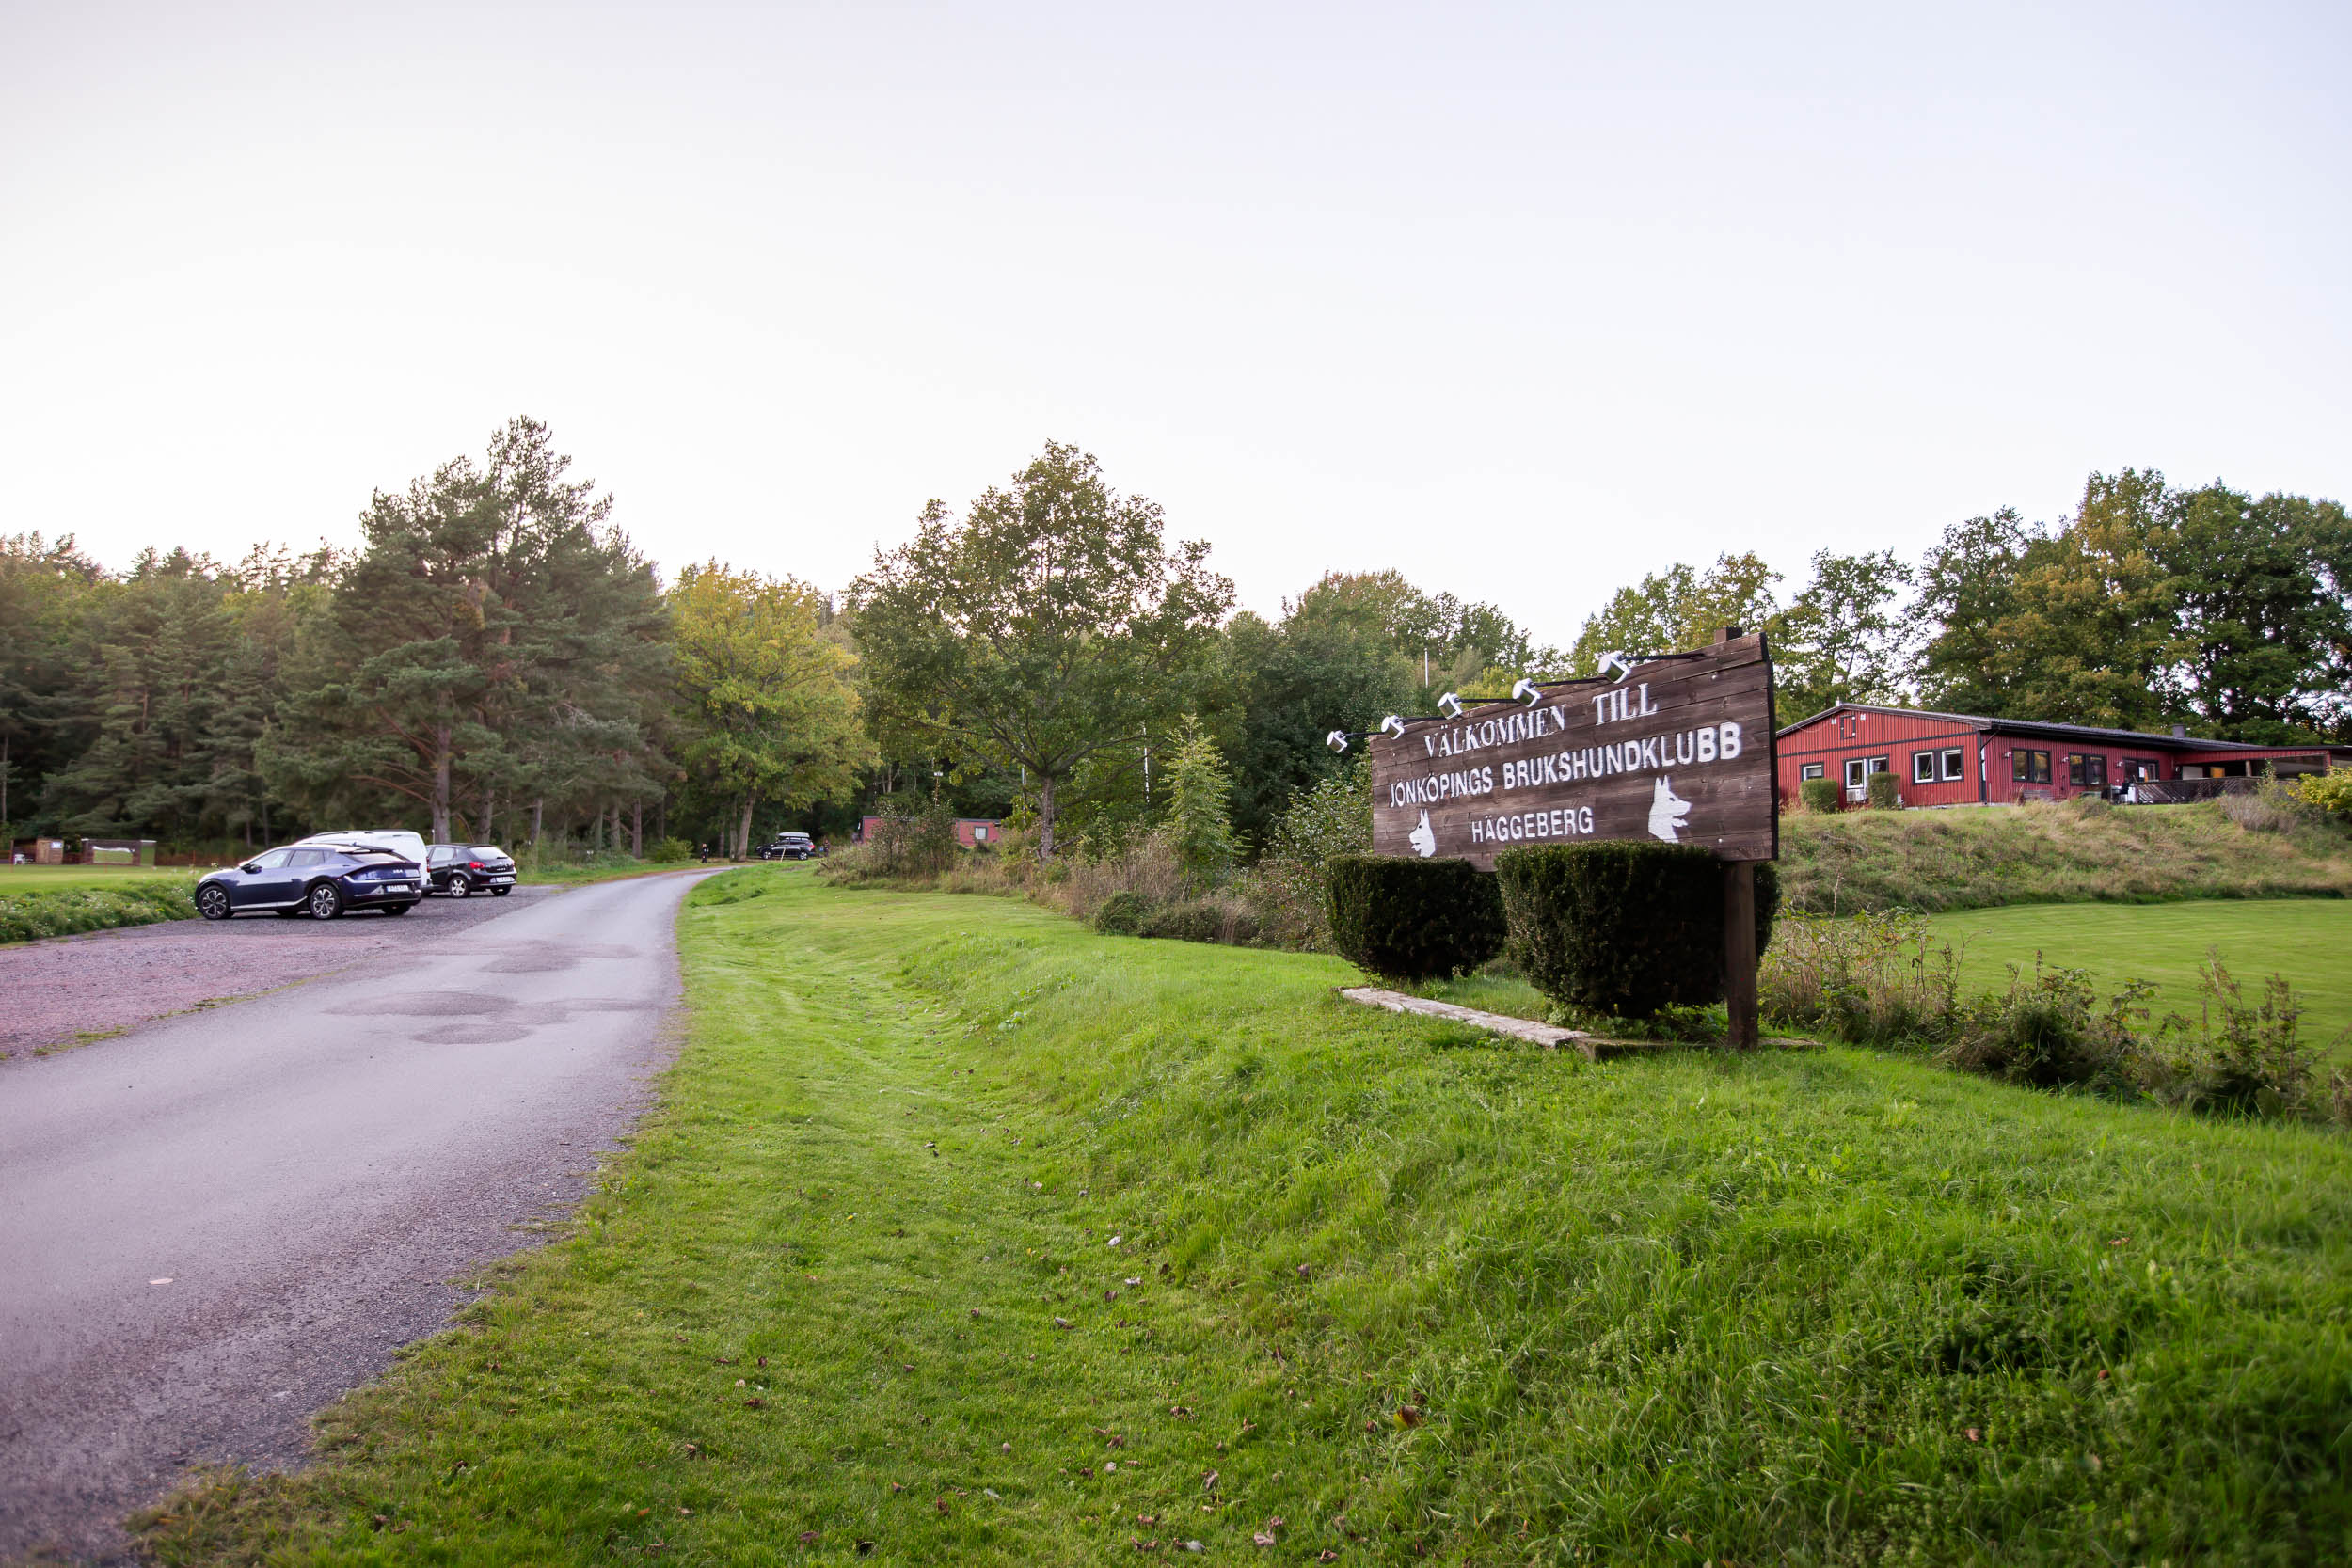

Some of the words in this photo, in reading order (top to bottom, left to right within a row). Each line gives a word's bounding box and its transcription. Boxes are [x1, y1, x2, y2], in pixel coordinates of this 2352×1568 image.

[1423, 704, 1566, 758] VÄLKOMMEN
[1592, 683, 1658, 725] TILL
[1390, 766, 1493, 808] JÖNKÖPINGS
[1502, 721, 1740, 790] BRUKSHUNDKLUBB
[1471, 806, 1594, 843] HÄGGEBERG
